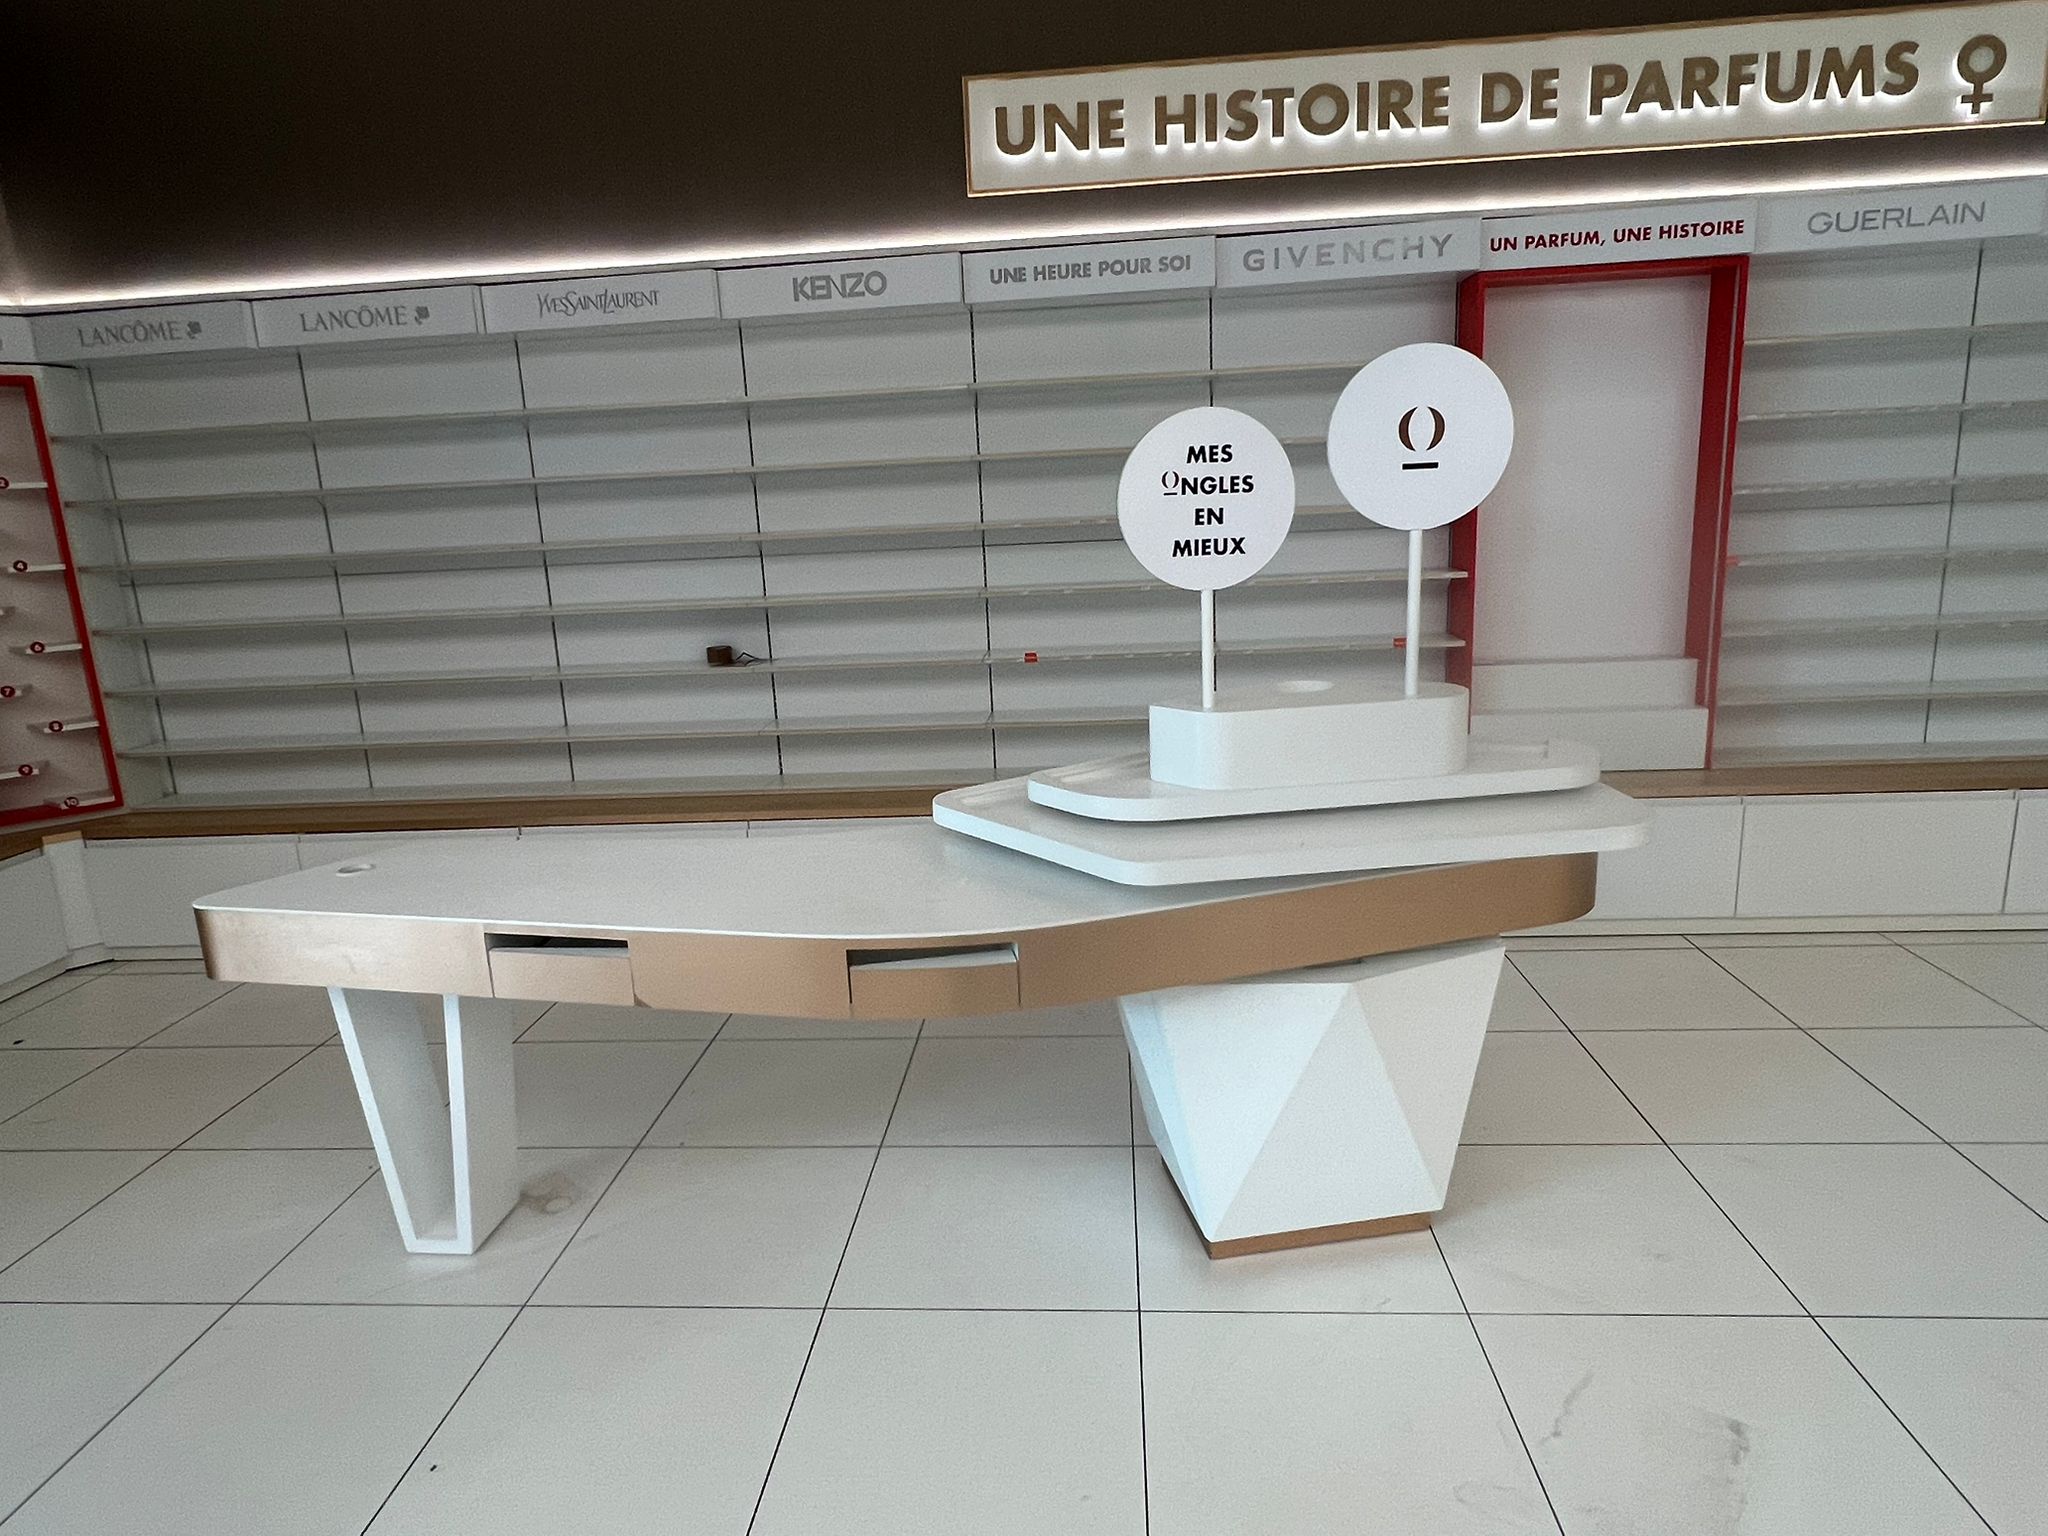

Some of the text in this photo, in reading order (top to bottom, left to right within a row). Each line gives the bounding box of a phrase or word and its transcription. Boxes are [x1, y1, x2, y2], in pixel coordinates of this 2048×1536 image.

[994, 41, 1920, 156] UNE HISTOIRE DE PARFUMS
[1807, 201, 1987, 235] GUERLAIN
[1490, 219, 1745, 252] UN PARFUM, UNE HISTOIRE
[1242, 233, 1453, 272] GIVENCHY
[989, 254, 1191, 285] UNE HEURE POUR SOI
[792, 270, 888, 302] KENZO
[78, 319, 179, 348] LANCÔME
[300, 305, 408, 333] LANCÔME
[1186, 444, 1233, 464] MES
[1194, 507, 1224, 526] EN
[1172, 537, 1246, 557] MIEUX
